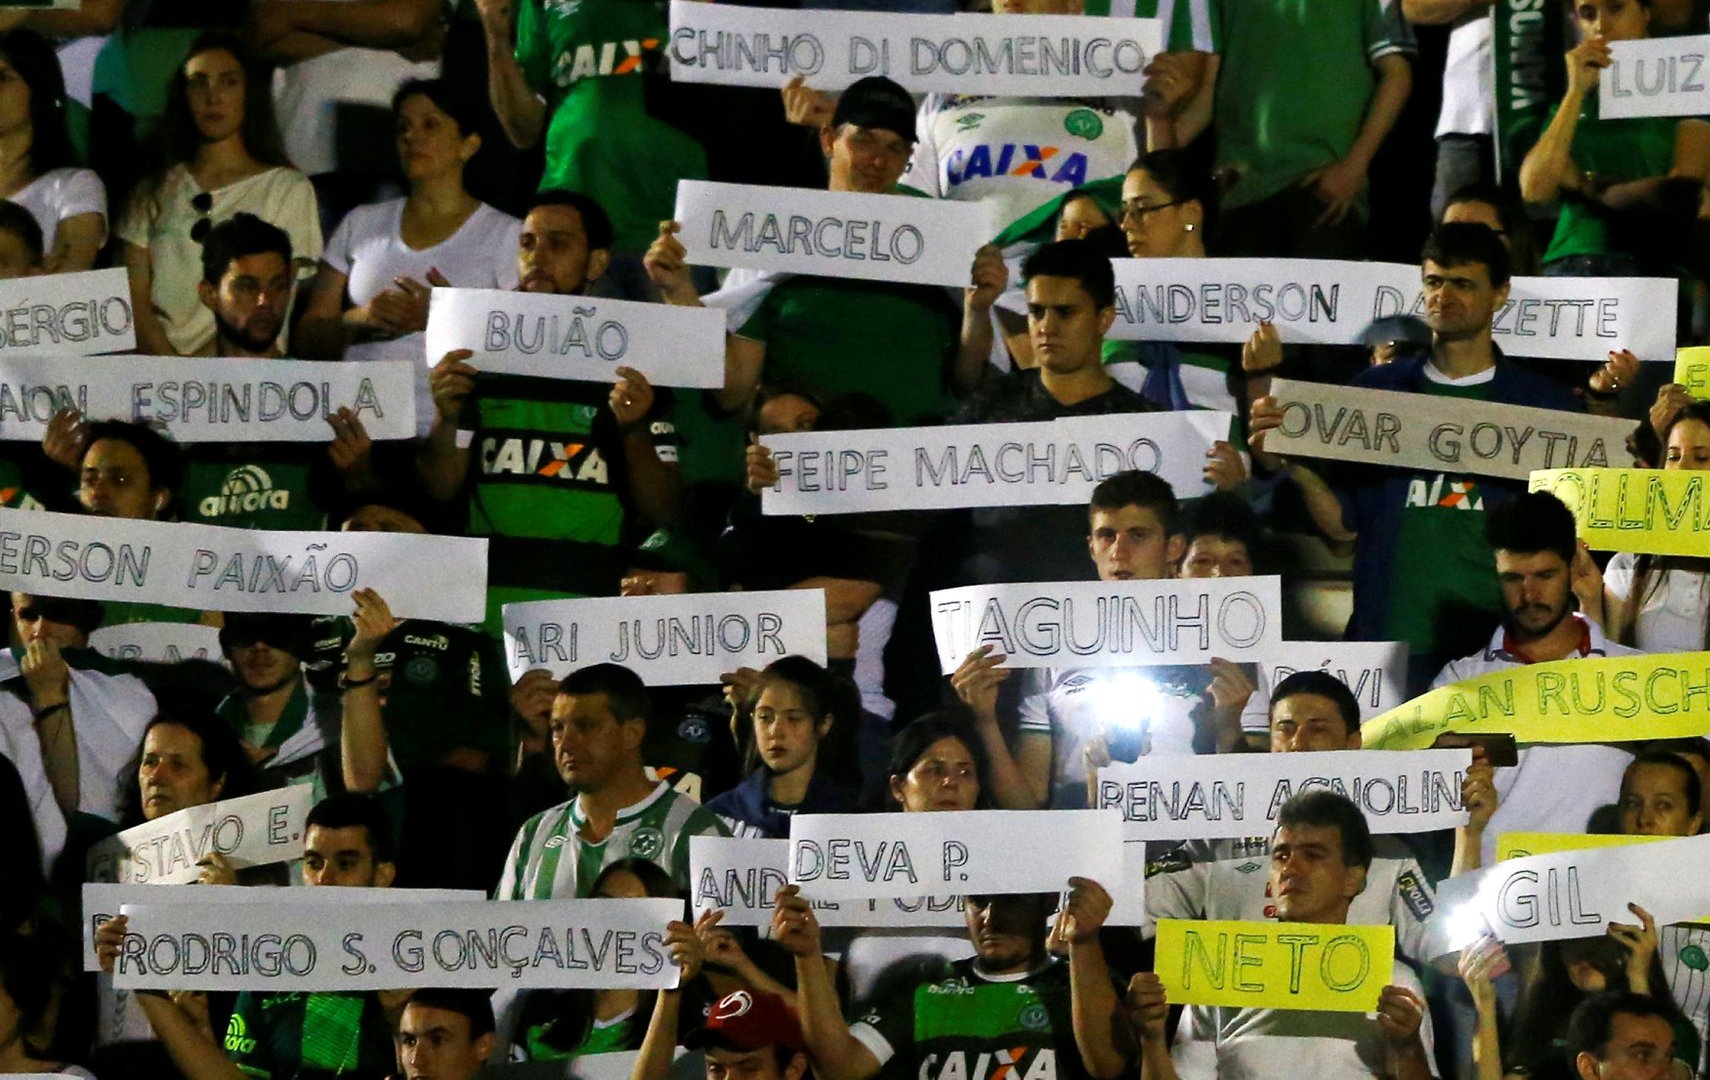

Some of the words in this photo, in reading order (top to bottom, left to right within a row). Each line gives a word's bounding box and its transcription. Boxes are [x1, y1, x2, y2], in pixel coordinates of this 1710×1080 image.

[553, 38, 660, 87] CAIX
[670, 26, 826, 76] CHINHO
[848, 36, 890, 75] DI
[910, 35, 1146, 79] DOMENICO
[1611, 54, 1705, 98] LUIZ
[947, 143, 1088, 189] CAIXA
[709, 209, 925, 265] MARCELO
[1114, 282, 1339, 325] ANDERSON
[484, 304, 629, 362] BUIÃO
[481, 437, 609, 485] CAIXA
[771, 448, 888, 493] FEIPE
[914, 436, 1163, 487] MACHADO
[1427, 421, 1609, 470] GOYTIA
[187, 542, 359, 593] PAIXÃO
[513, 623, 578, 668] ARI
[610, 613, 785, 663] JUNIOR
[937, 589, 1267, 659] TIAGUINHO
[1100, 778, 1245, 822] RENAN
[267, 805, 300, 845] E.
[794, 838, 918, 884] DEVA
[942, 839, 970, 882] P.
[694, 866, 838, 911] AND
[1496, 865, 1601, 930] GIL
[119, 932, 318, 977] RODRIGO
[342, 931, 376, 975] S.
[391, 924, 664, 978] GONÇALVES
[1182, 933, 1370, 994] NETO
[918, 1045, 1058, 1080] CAIXA
